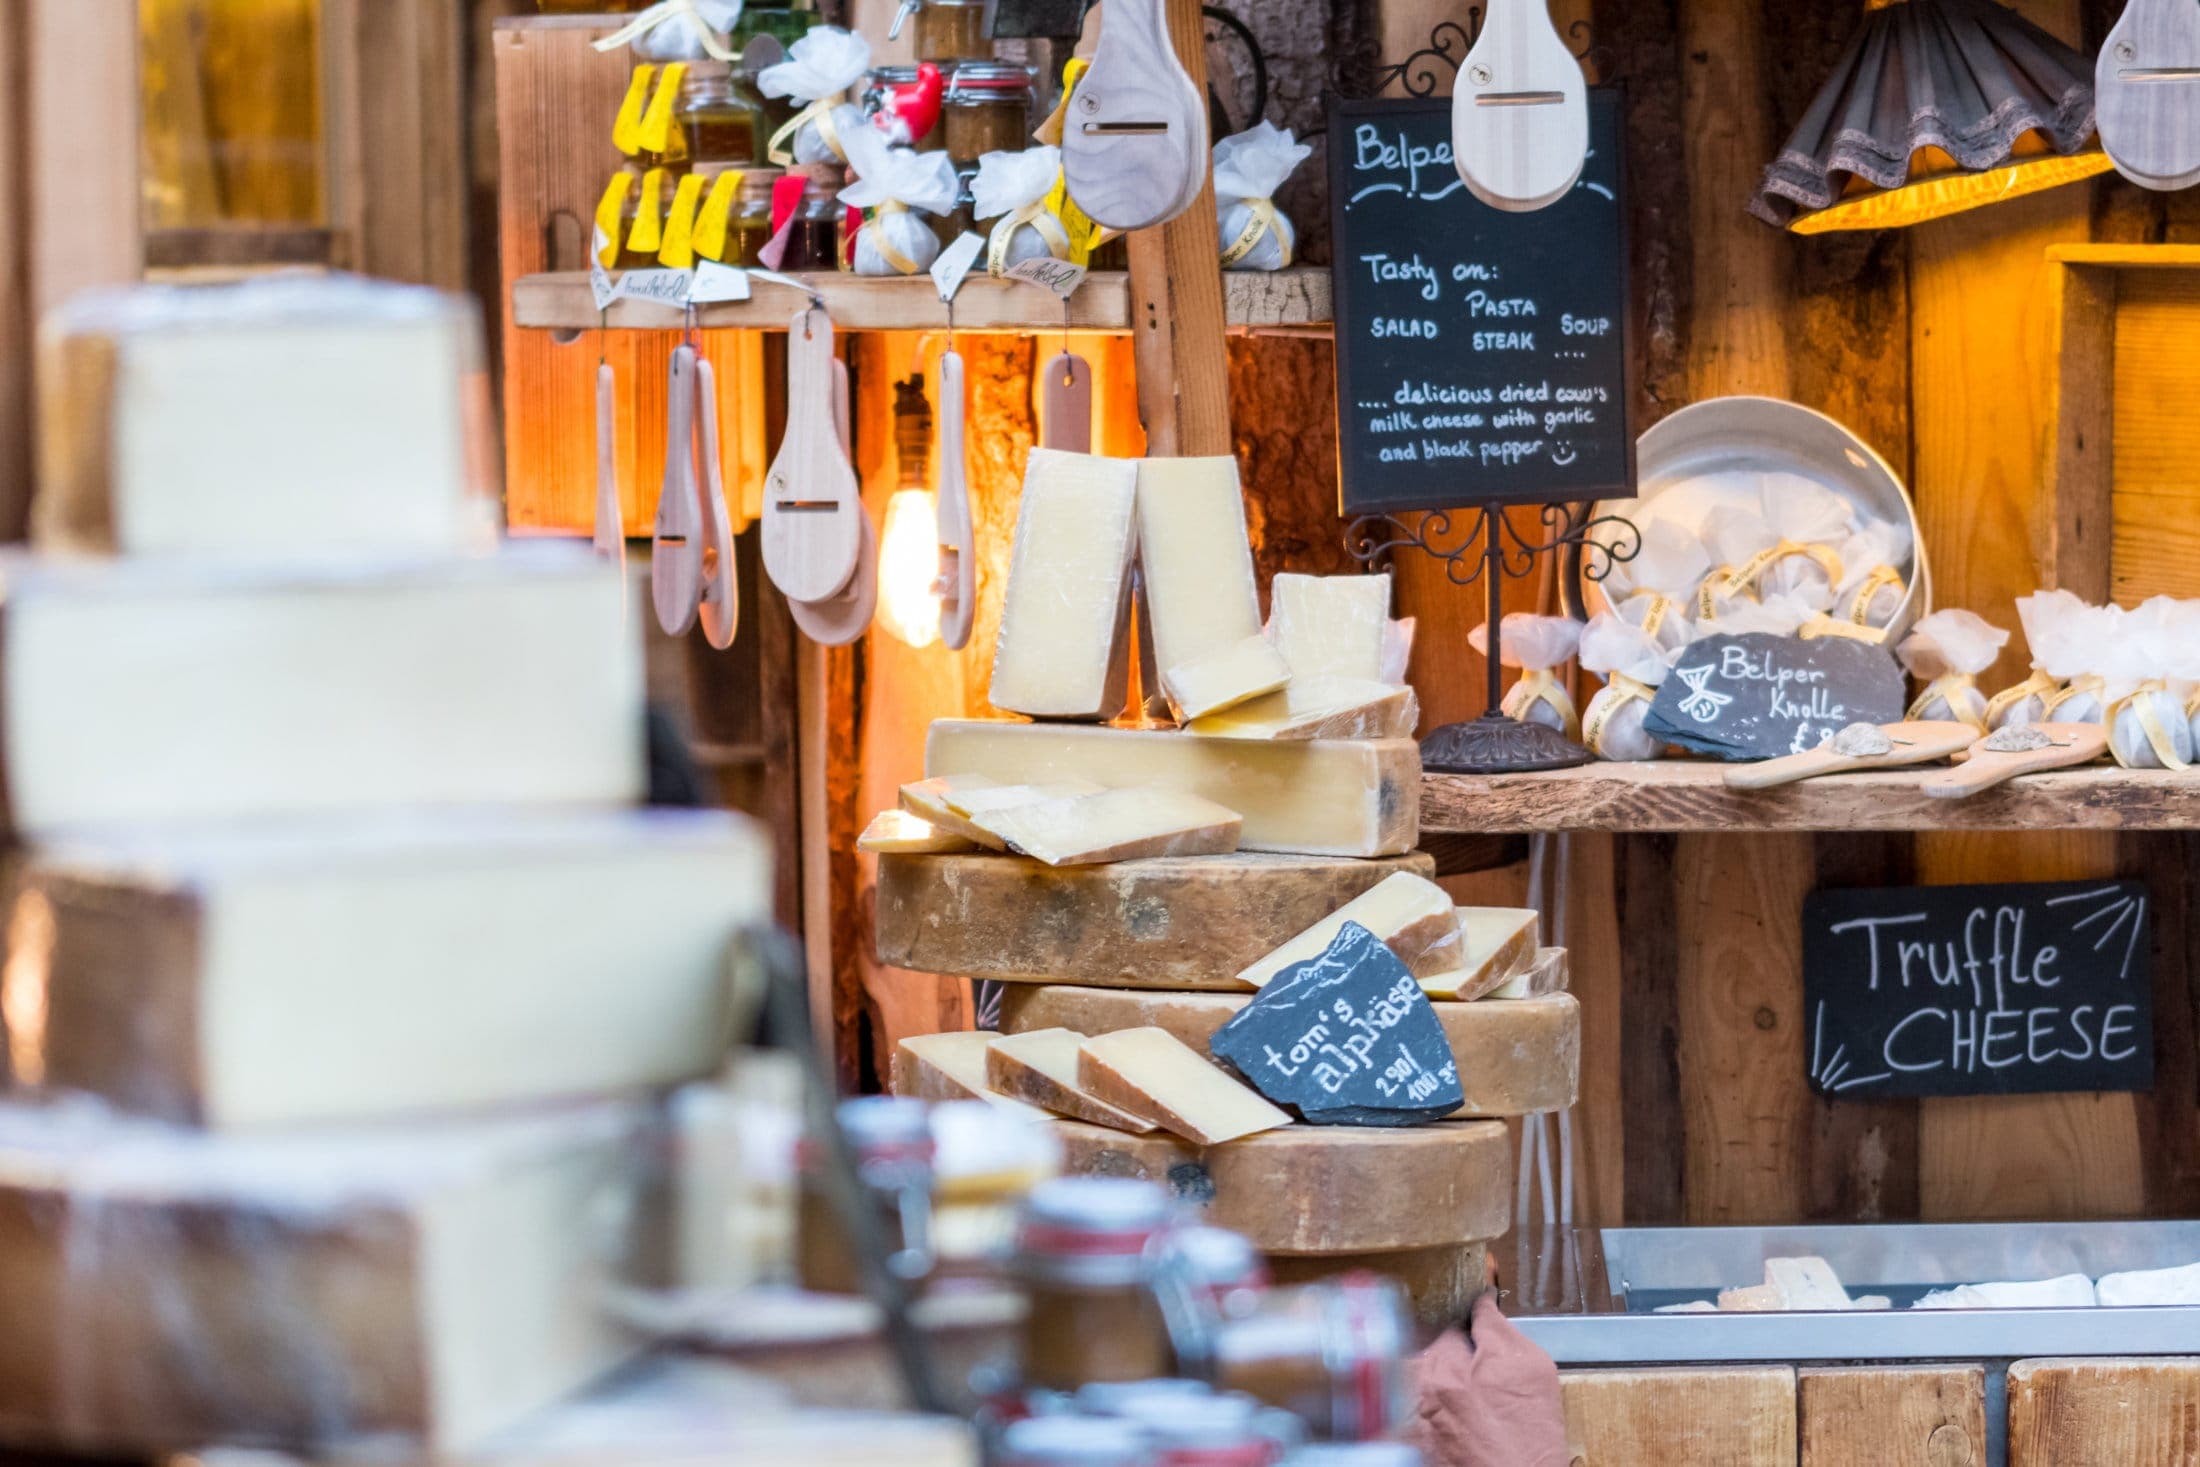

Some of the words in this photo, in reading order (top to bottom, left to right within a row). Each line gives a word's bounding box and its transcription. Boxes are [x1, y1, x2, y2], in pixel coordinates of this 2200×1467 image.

[1354, 123, 1455, 191] Belpe
[1360, 254, 1439, 300] Tasty
[1453, 264, 1499, 281] on:
[1371, 318, 1438, 340] SALAD
[1473, 332, 1535, 351] STEAK
[1394, 380, 1492, 405] delicious
[1499, 380, 1548, 402] dried
[1369, 412, 1418, 432] milk
[1422, 415, 1484, 430] cheese
[1492, 407, 1536, 429] with
[1544, 407, 1595, 434] garlic
[1379, 444, 1417, 462] and
[1422, 440, 1473, 460] black
[1479, 440, 1543, 466] pepper
[1719, 645, 1825, 691] Belper
[1769, 686, 1846, 721] Knolle
[1830, 906, 2061, 1011] Truffle
[1263, 998, 1354, 1076] tom's
[1884, 1005, 2137, 1073] CHEESE
